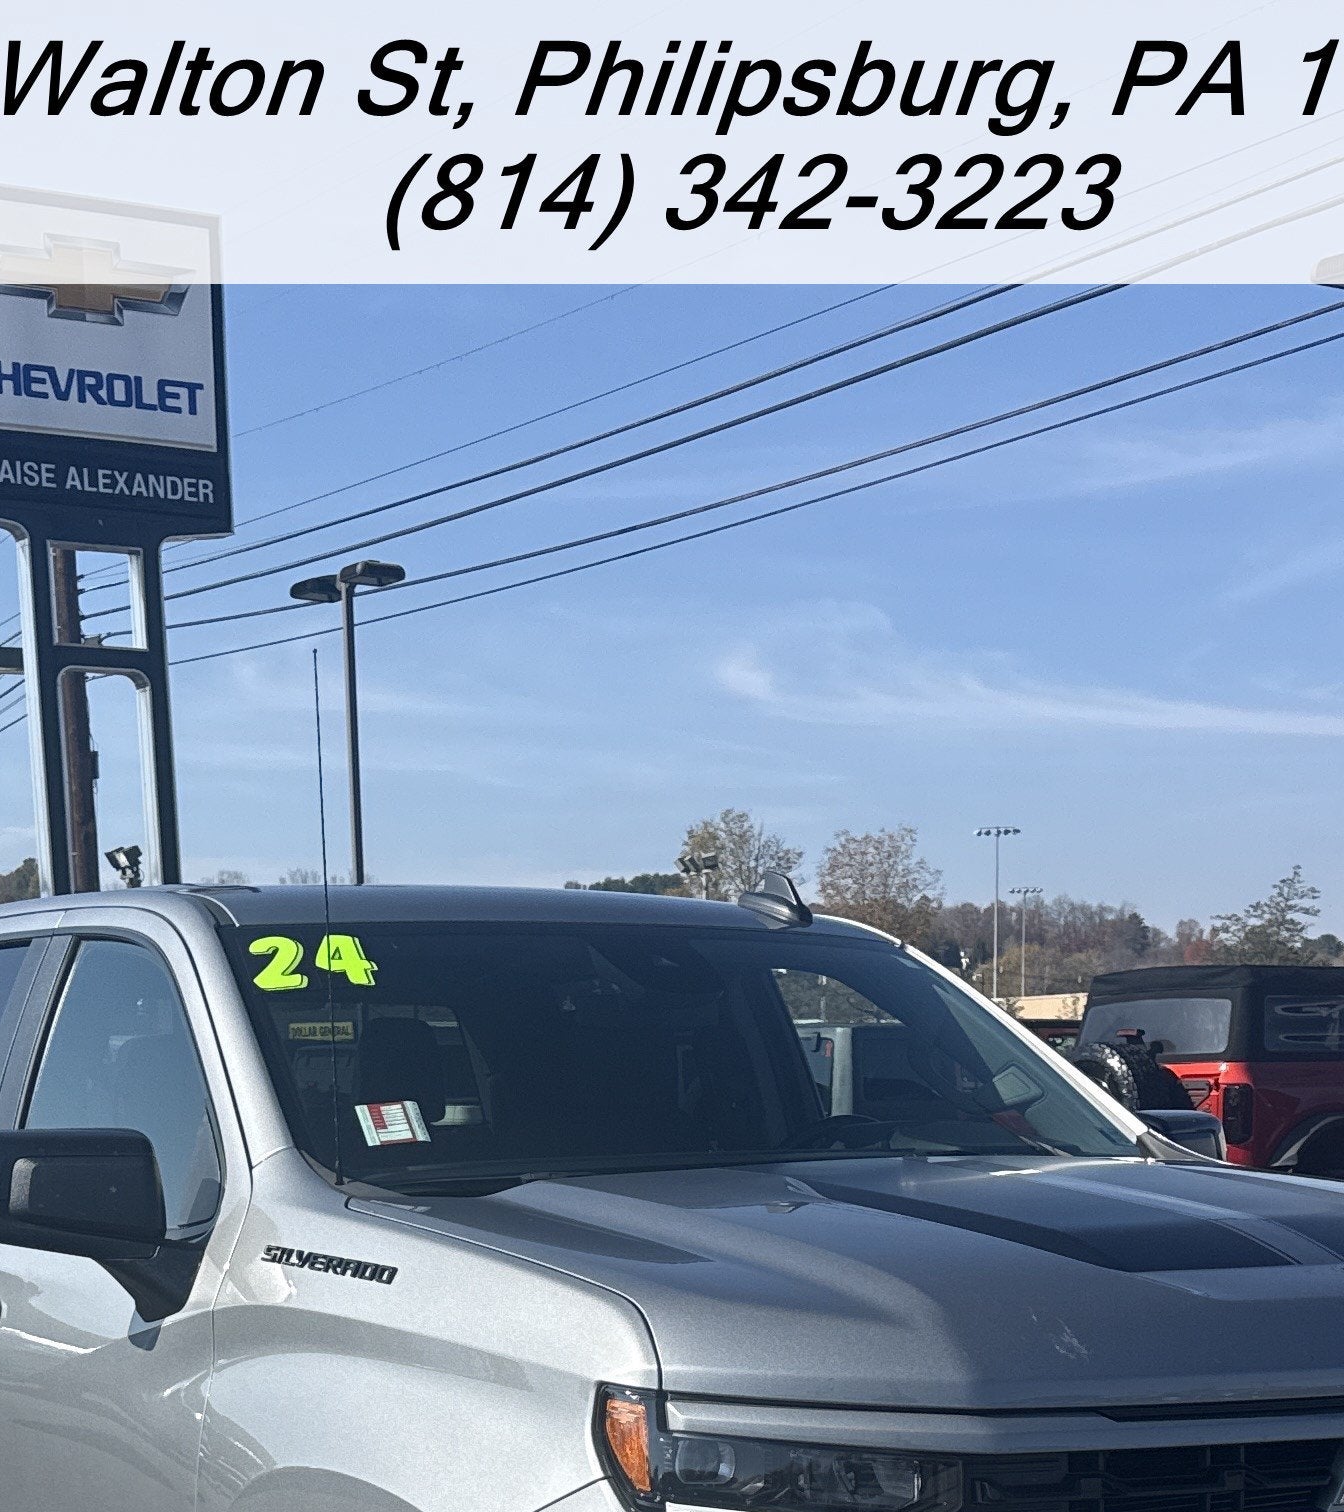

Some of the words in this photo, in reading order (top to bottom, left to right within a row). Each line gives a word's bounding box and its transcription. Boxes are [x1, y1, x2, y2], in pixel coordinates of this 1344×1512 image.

[65, 466, 214, 503] ALEXANDER
[249, 934, 378, 991] 24
[260, 1244, 398, 1285] SILVERADO
